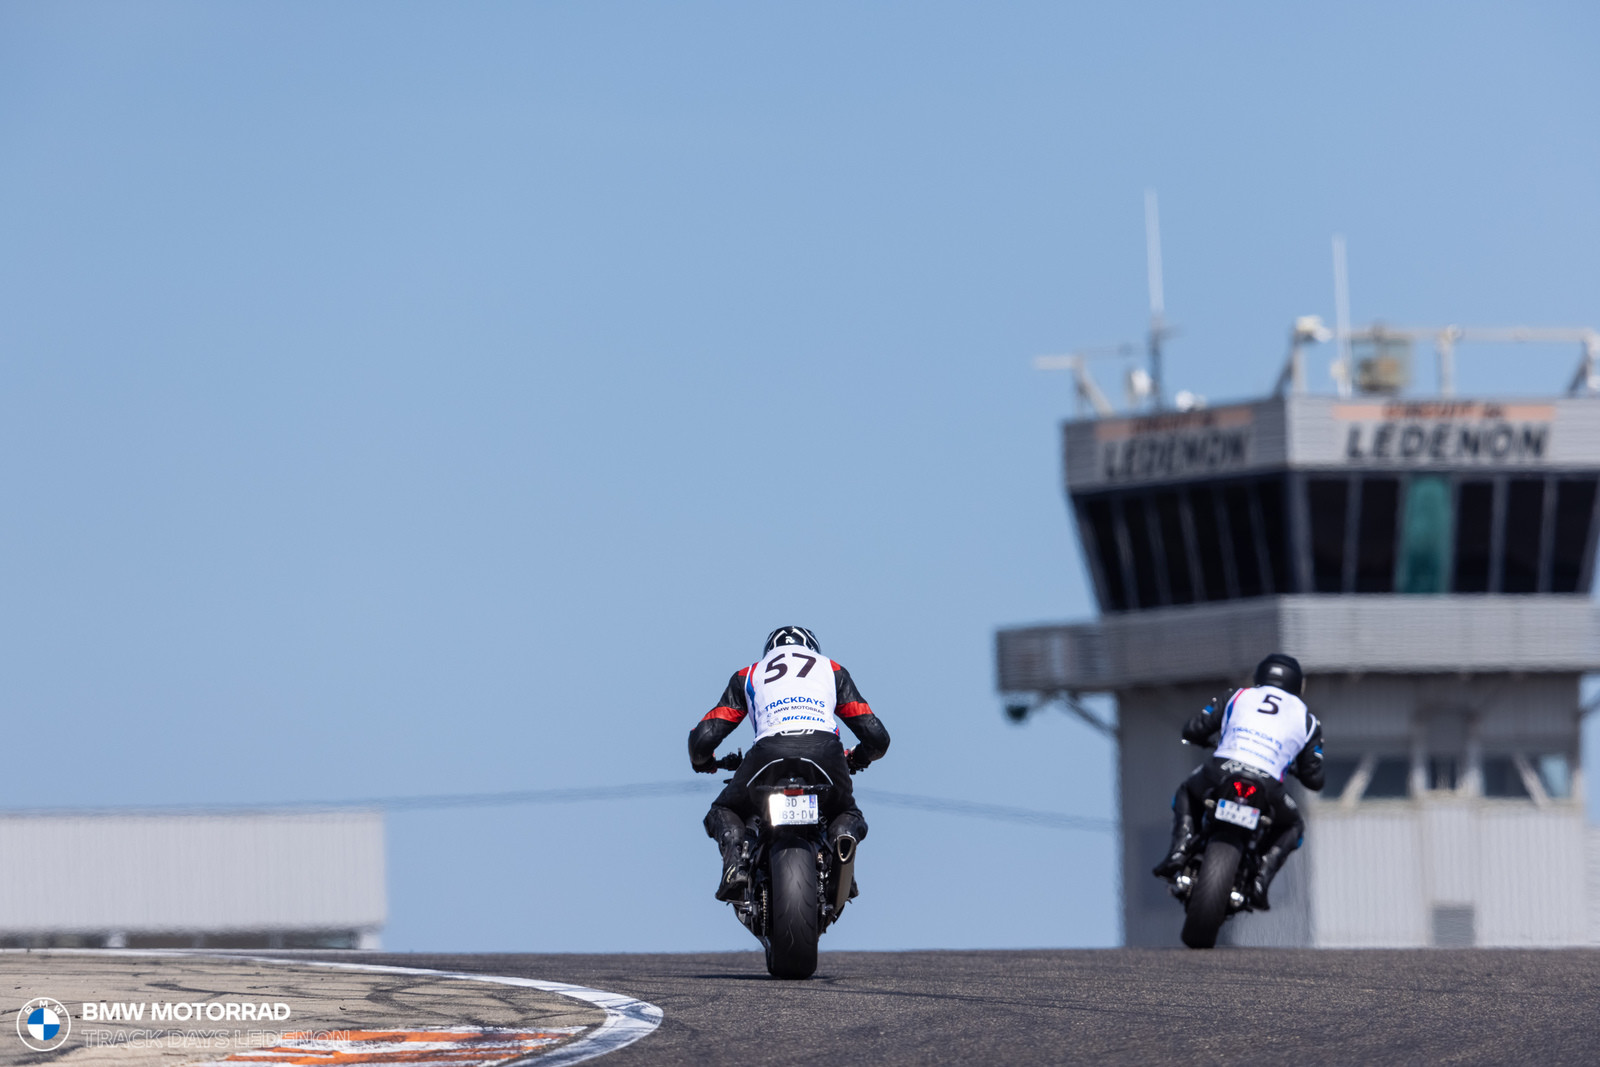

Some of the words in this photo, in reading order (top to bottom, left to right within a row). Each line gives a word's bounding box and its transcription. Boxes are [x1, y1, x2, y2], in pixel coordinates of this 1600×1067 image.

[1346, 422, 1550, 459] LEDENON
[763, 652, 817, 685] 57
[764, 696, 825, 712] TRACKDAYS
[1257, 694, 1283, 715] 5
[781, 715, 826, 723] MICHELIN
